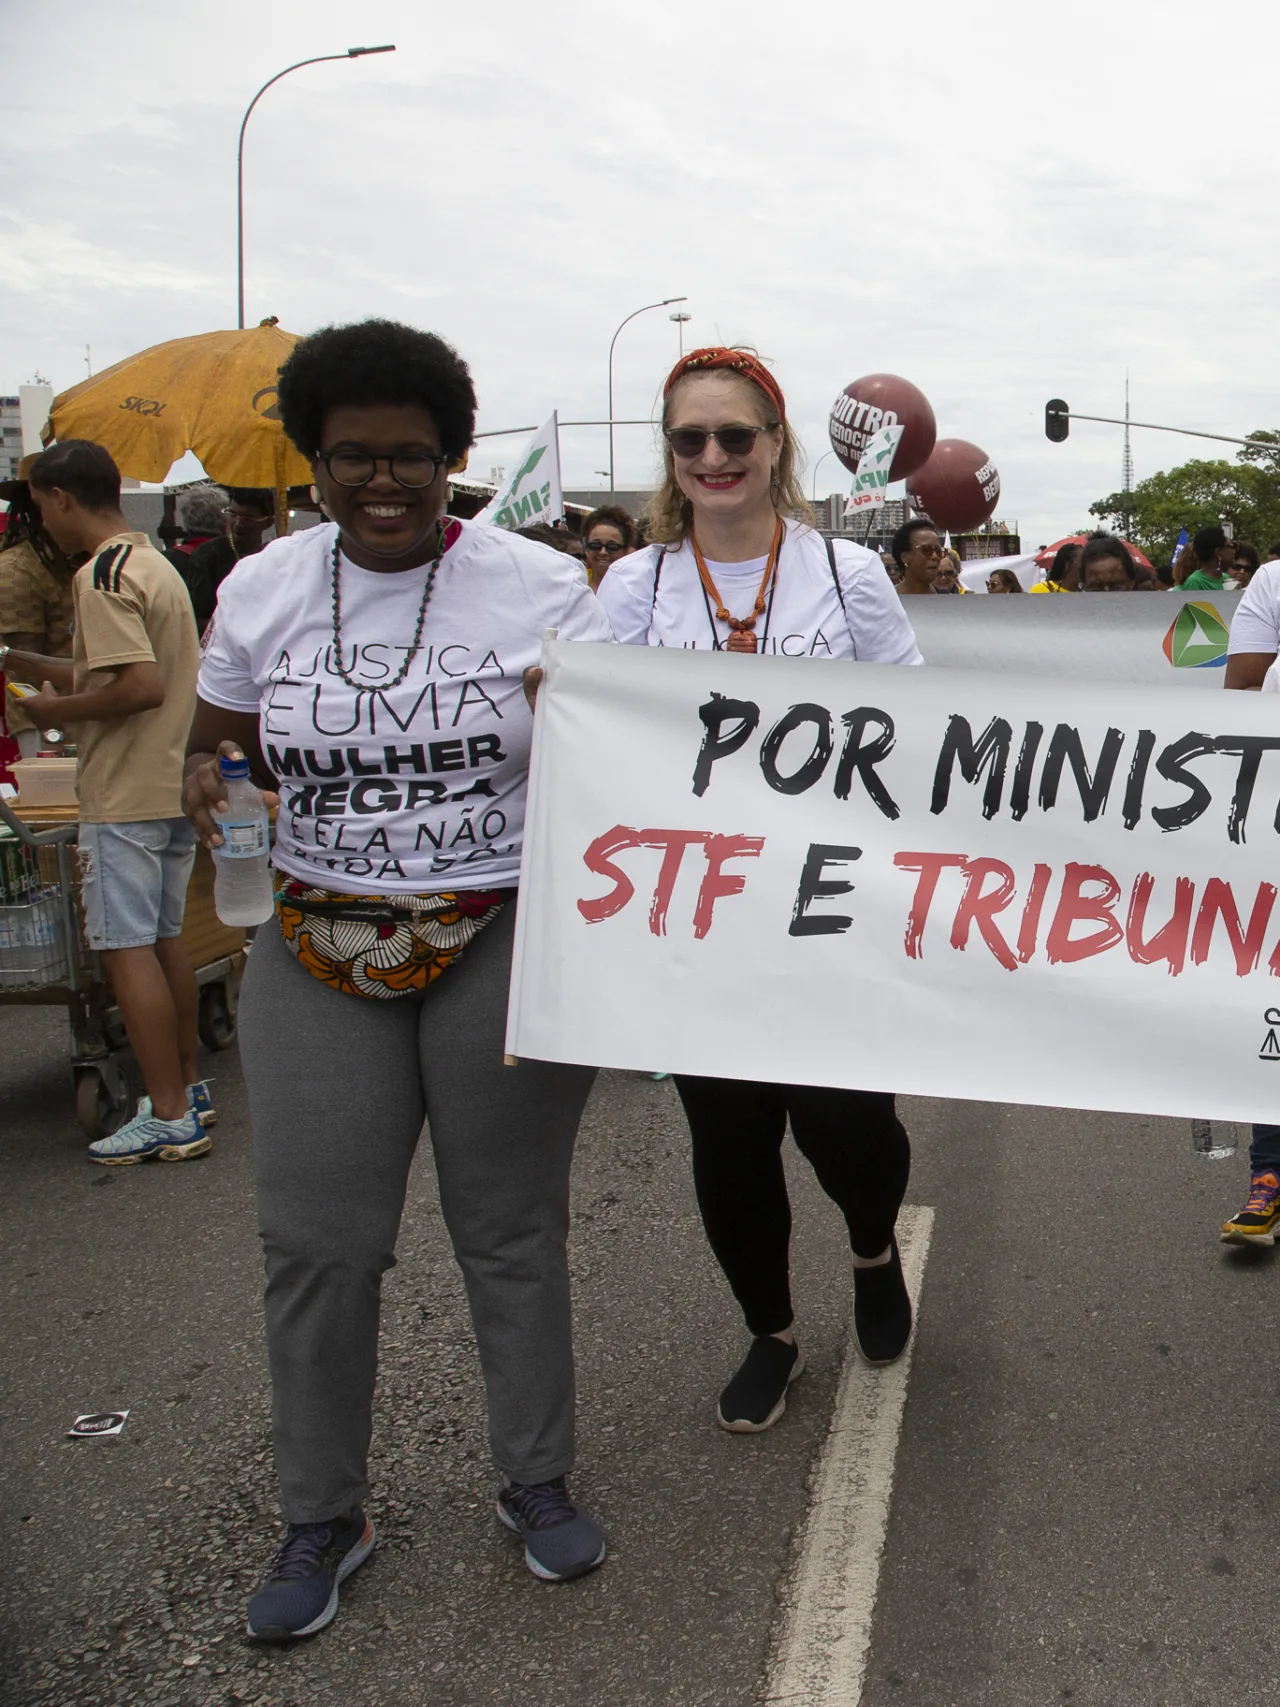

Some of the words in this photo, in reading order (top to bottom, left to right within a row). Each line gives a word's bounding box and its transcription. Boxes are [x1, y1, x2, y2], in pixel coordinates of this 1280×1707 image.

[118, 396, 167, 418] SKOL
[269, 650, 291, 682] A
[312, 680, 504, 737] UMA
[266, 733, 508, 778] MULHER
[692, 691, 901, 821] POR
[315, 818, 391, 853] ELA
[414, 806, 507, 852] NÃO
[577, 824, 767, 940] STF
[788, 843, 863, 937] E
